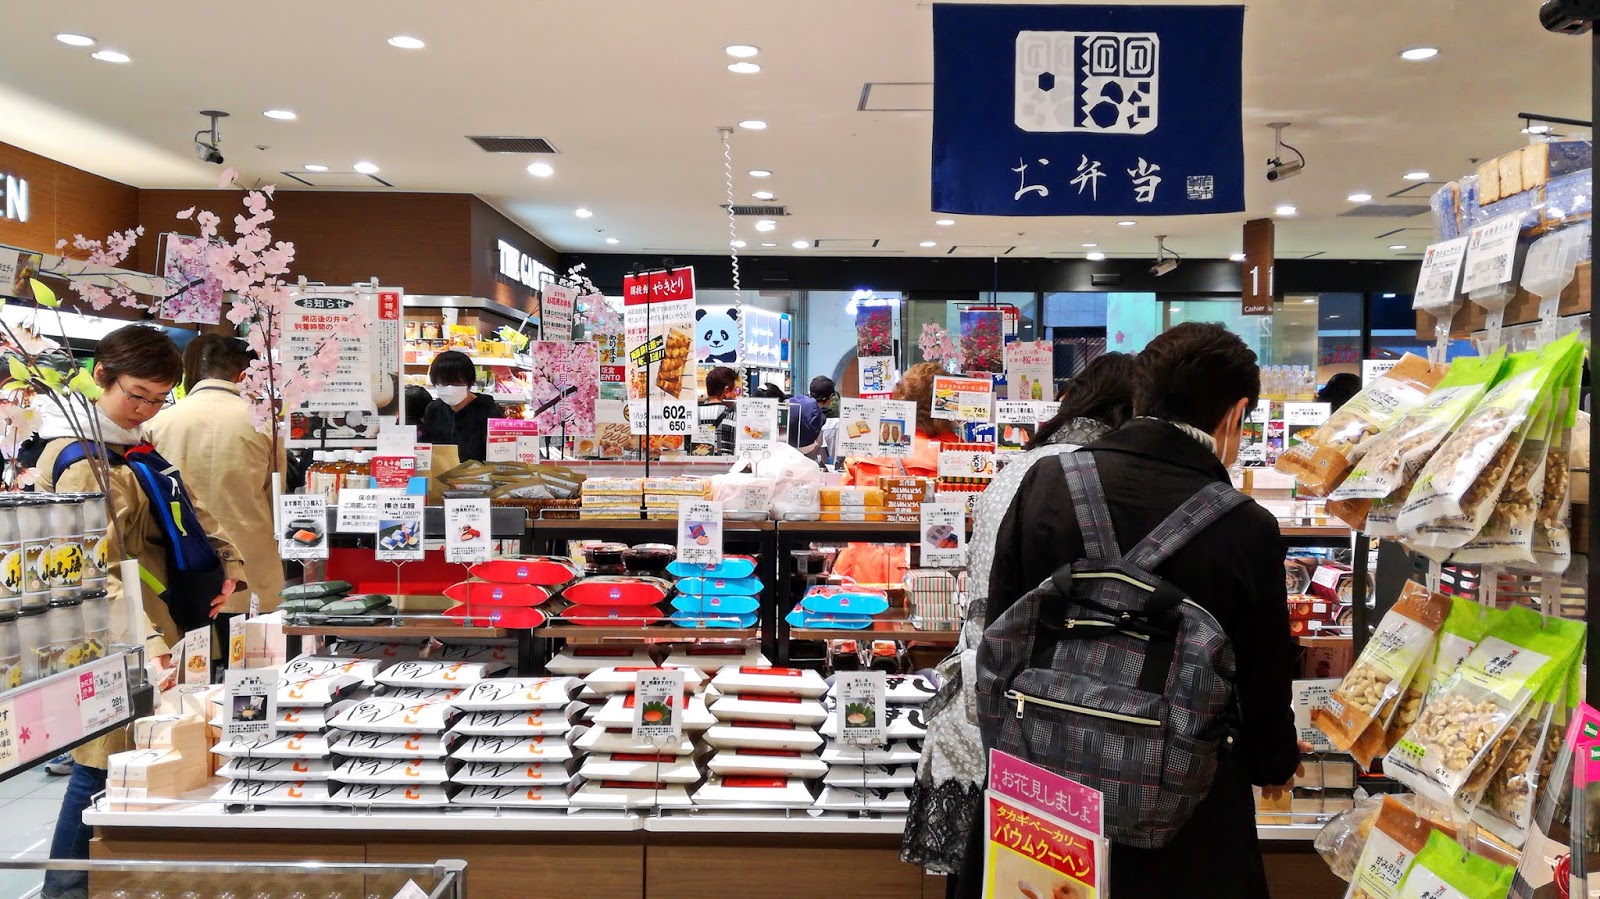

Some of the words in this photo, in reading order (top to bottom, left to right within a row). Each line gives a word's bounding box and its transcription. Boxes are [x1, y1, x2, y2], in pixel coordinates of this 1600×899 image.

[1011, 154, 1162, 203] お弁当
[652, 276, 684, 296] やきとり
[1249, 266, 1259, 296] 1
[303, 299, 347, 309] お知らせ
[1244, 305, 1266, 313] Cashier
[1001, 768, 1092, 824] お花見しましょ
[996, 805, 1088, 851] タカギベーカリー
[993, 823, 1091, 878] バウムクーヘン
